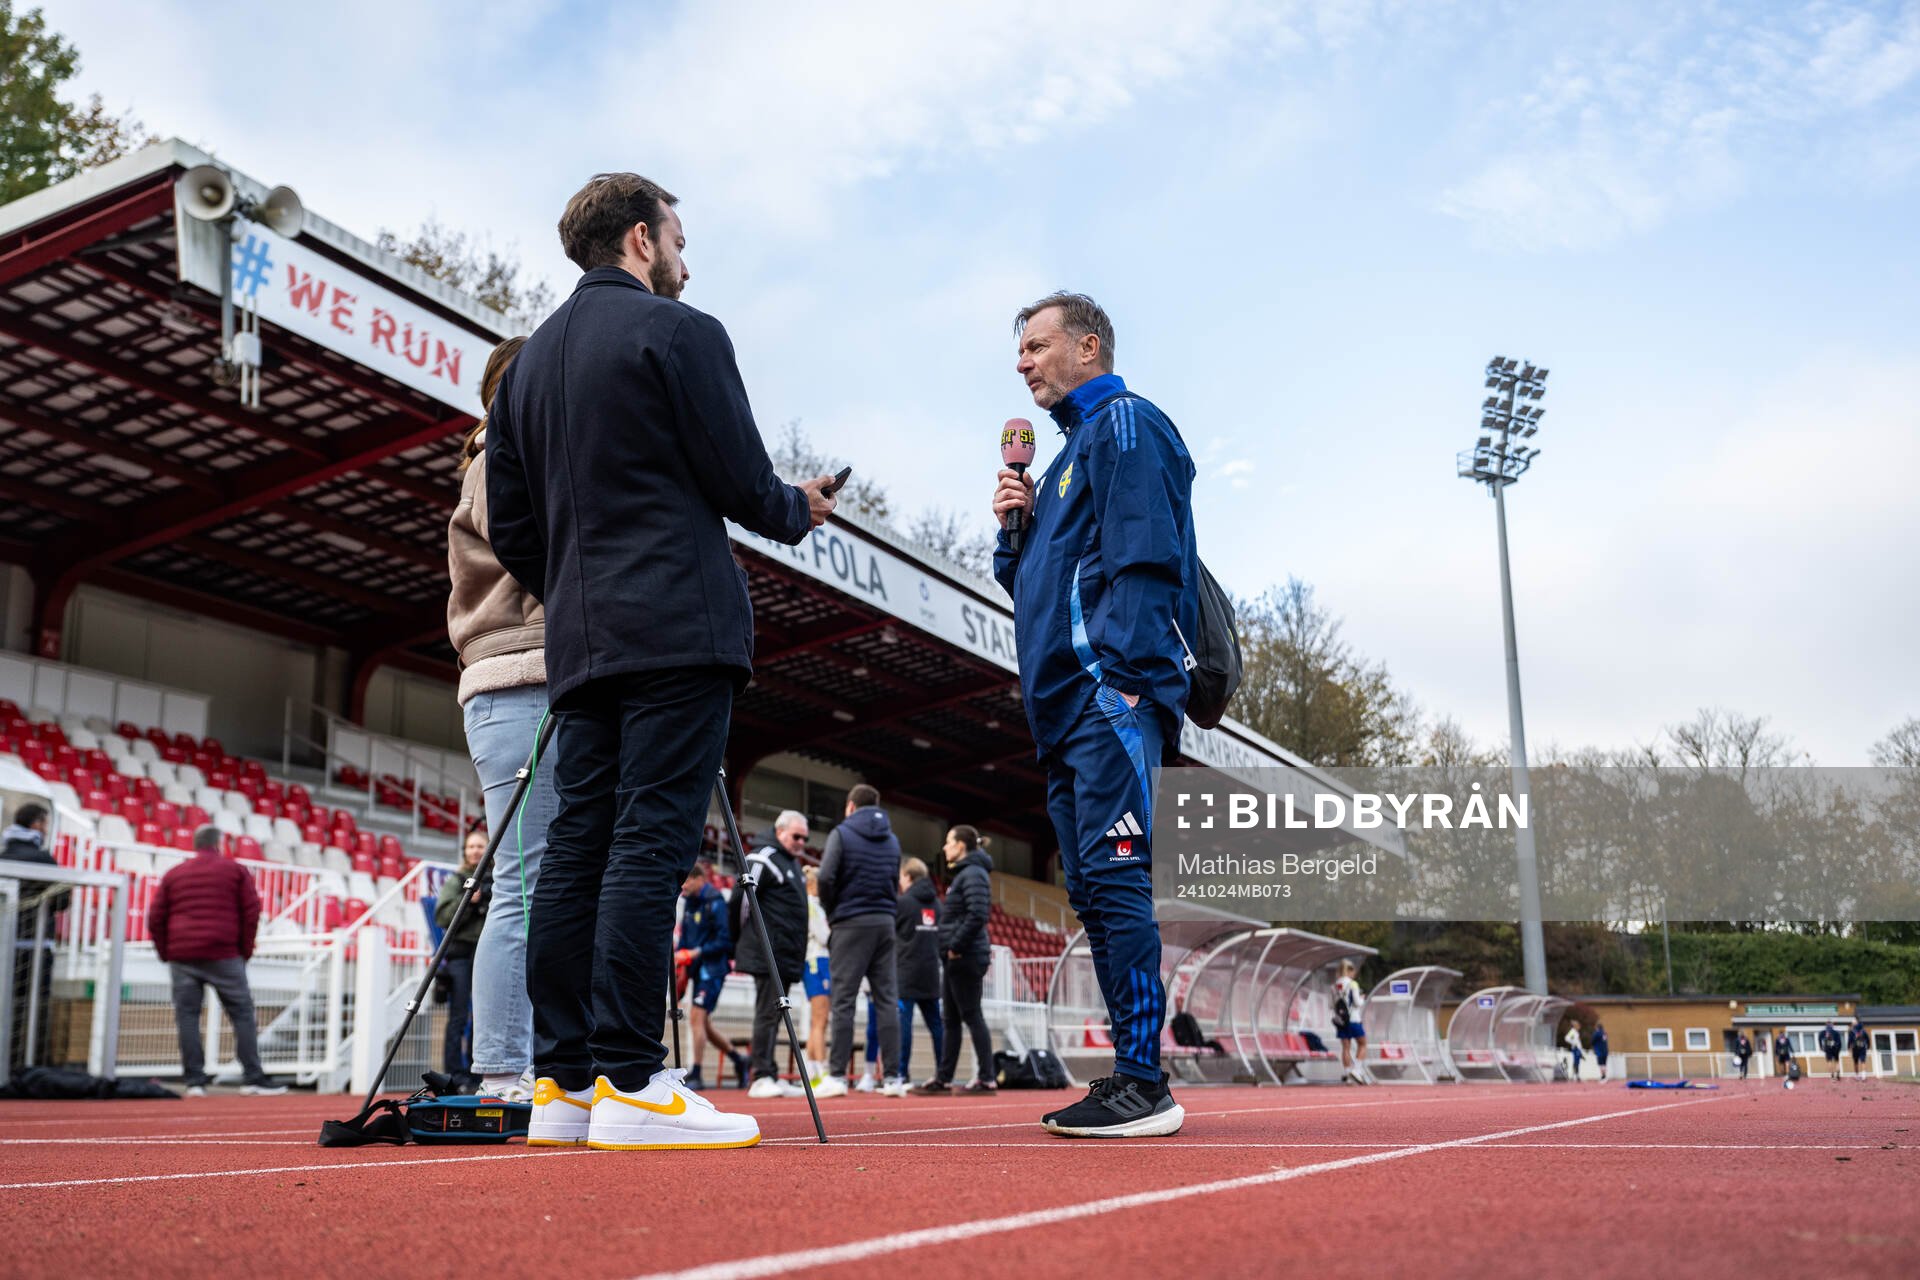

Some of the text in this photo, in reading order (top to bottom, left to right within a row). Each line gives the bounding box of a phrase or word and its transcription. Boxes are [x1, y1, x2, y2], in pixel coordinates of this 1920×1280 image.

[287, 265, 357, 335] WE
[370, 308, 463, 386] RUN
[811, 528, 888, 602] FOLA
